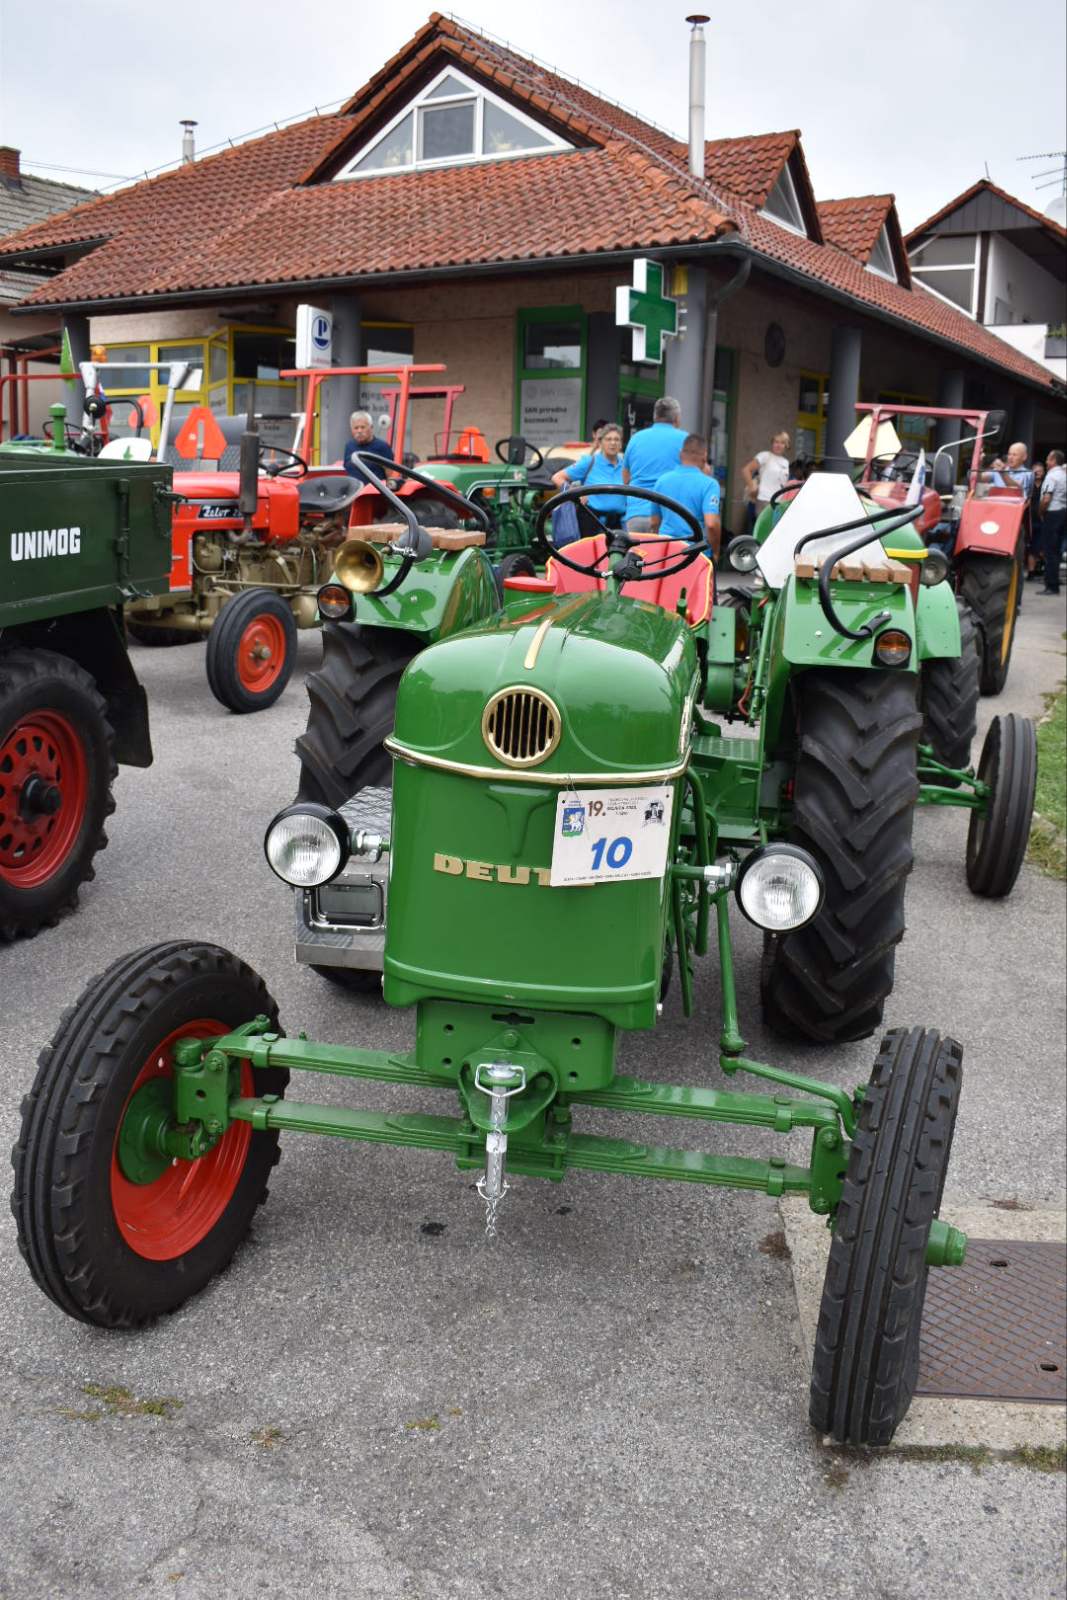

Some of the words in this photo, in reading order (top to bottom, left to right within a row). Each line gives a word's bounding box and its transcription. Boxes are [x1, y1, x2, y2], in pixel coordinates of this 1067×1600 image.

[10, 526, 81, 562] UNIMOG
[587, 800, 606, 817] 19.
[433, 853, 552, 886] DEUT
[591, 836, 633, 870] 10
